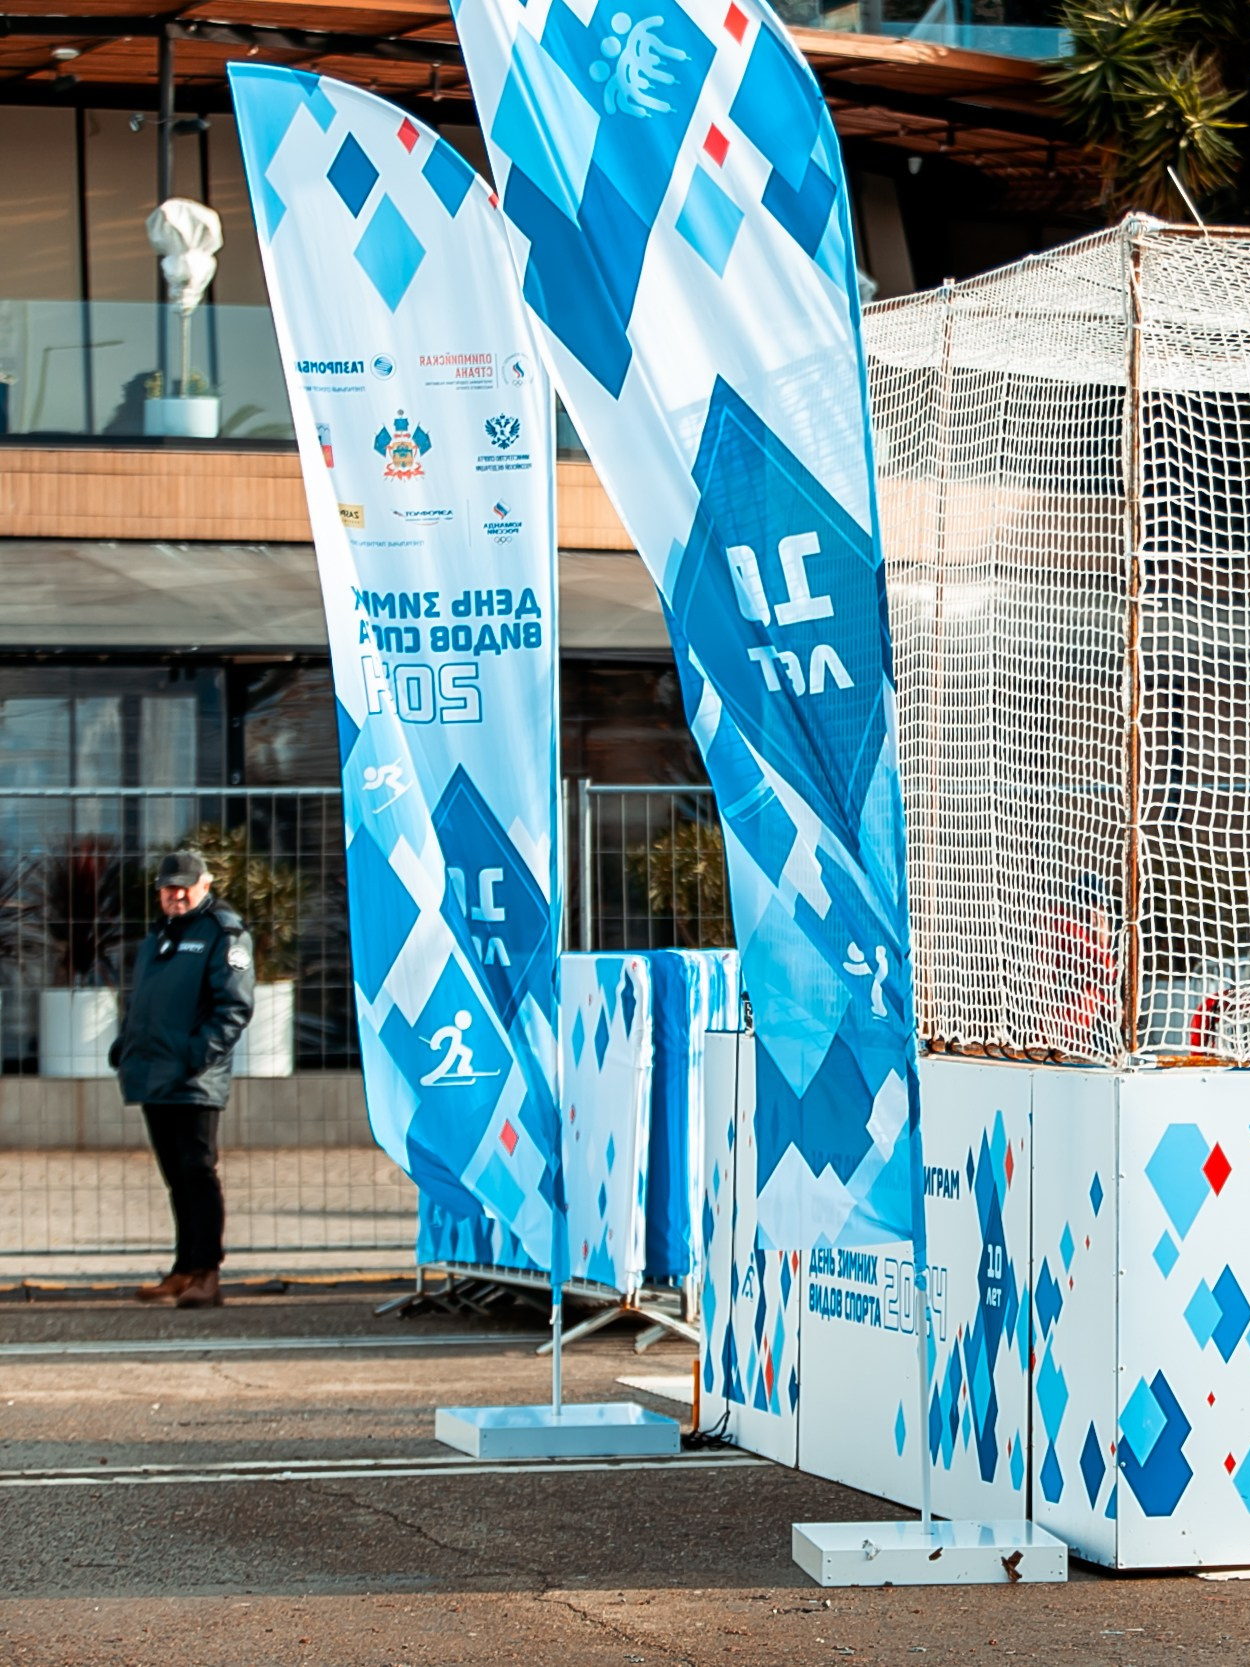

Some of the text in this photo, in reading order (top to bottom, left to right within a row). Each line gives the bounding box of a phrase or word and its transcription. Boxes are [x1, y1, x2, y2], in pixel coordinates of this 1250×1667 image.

[809, 1248, 878, 1286] ДЕНЬ ЗИМНИХ
[987, 1244, 1002, 1279] 10
[809, 1283, 882, 1328] ВИДОВ СПОРТА
